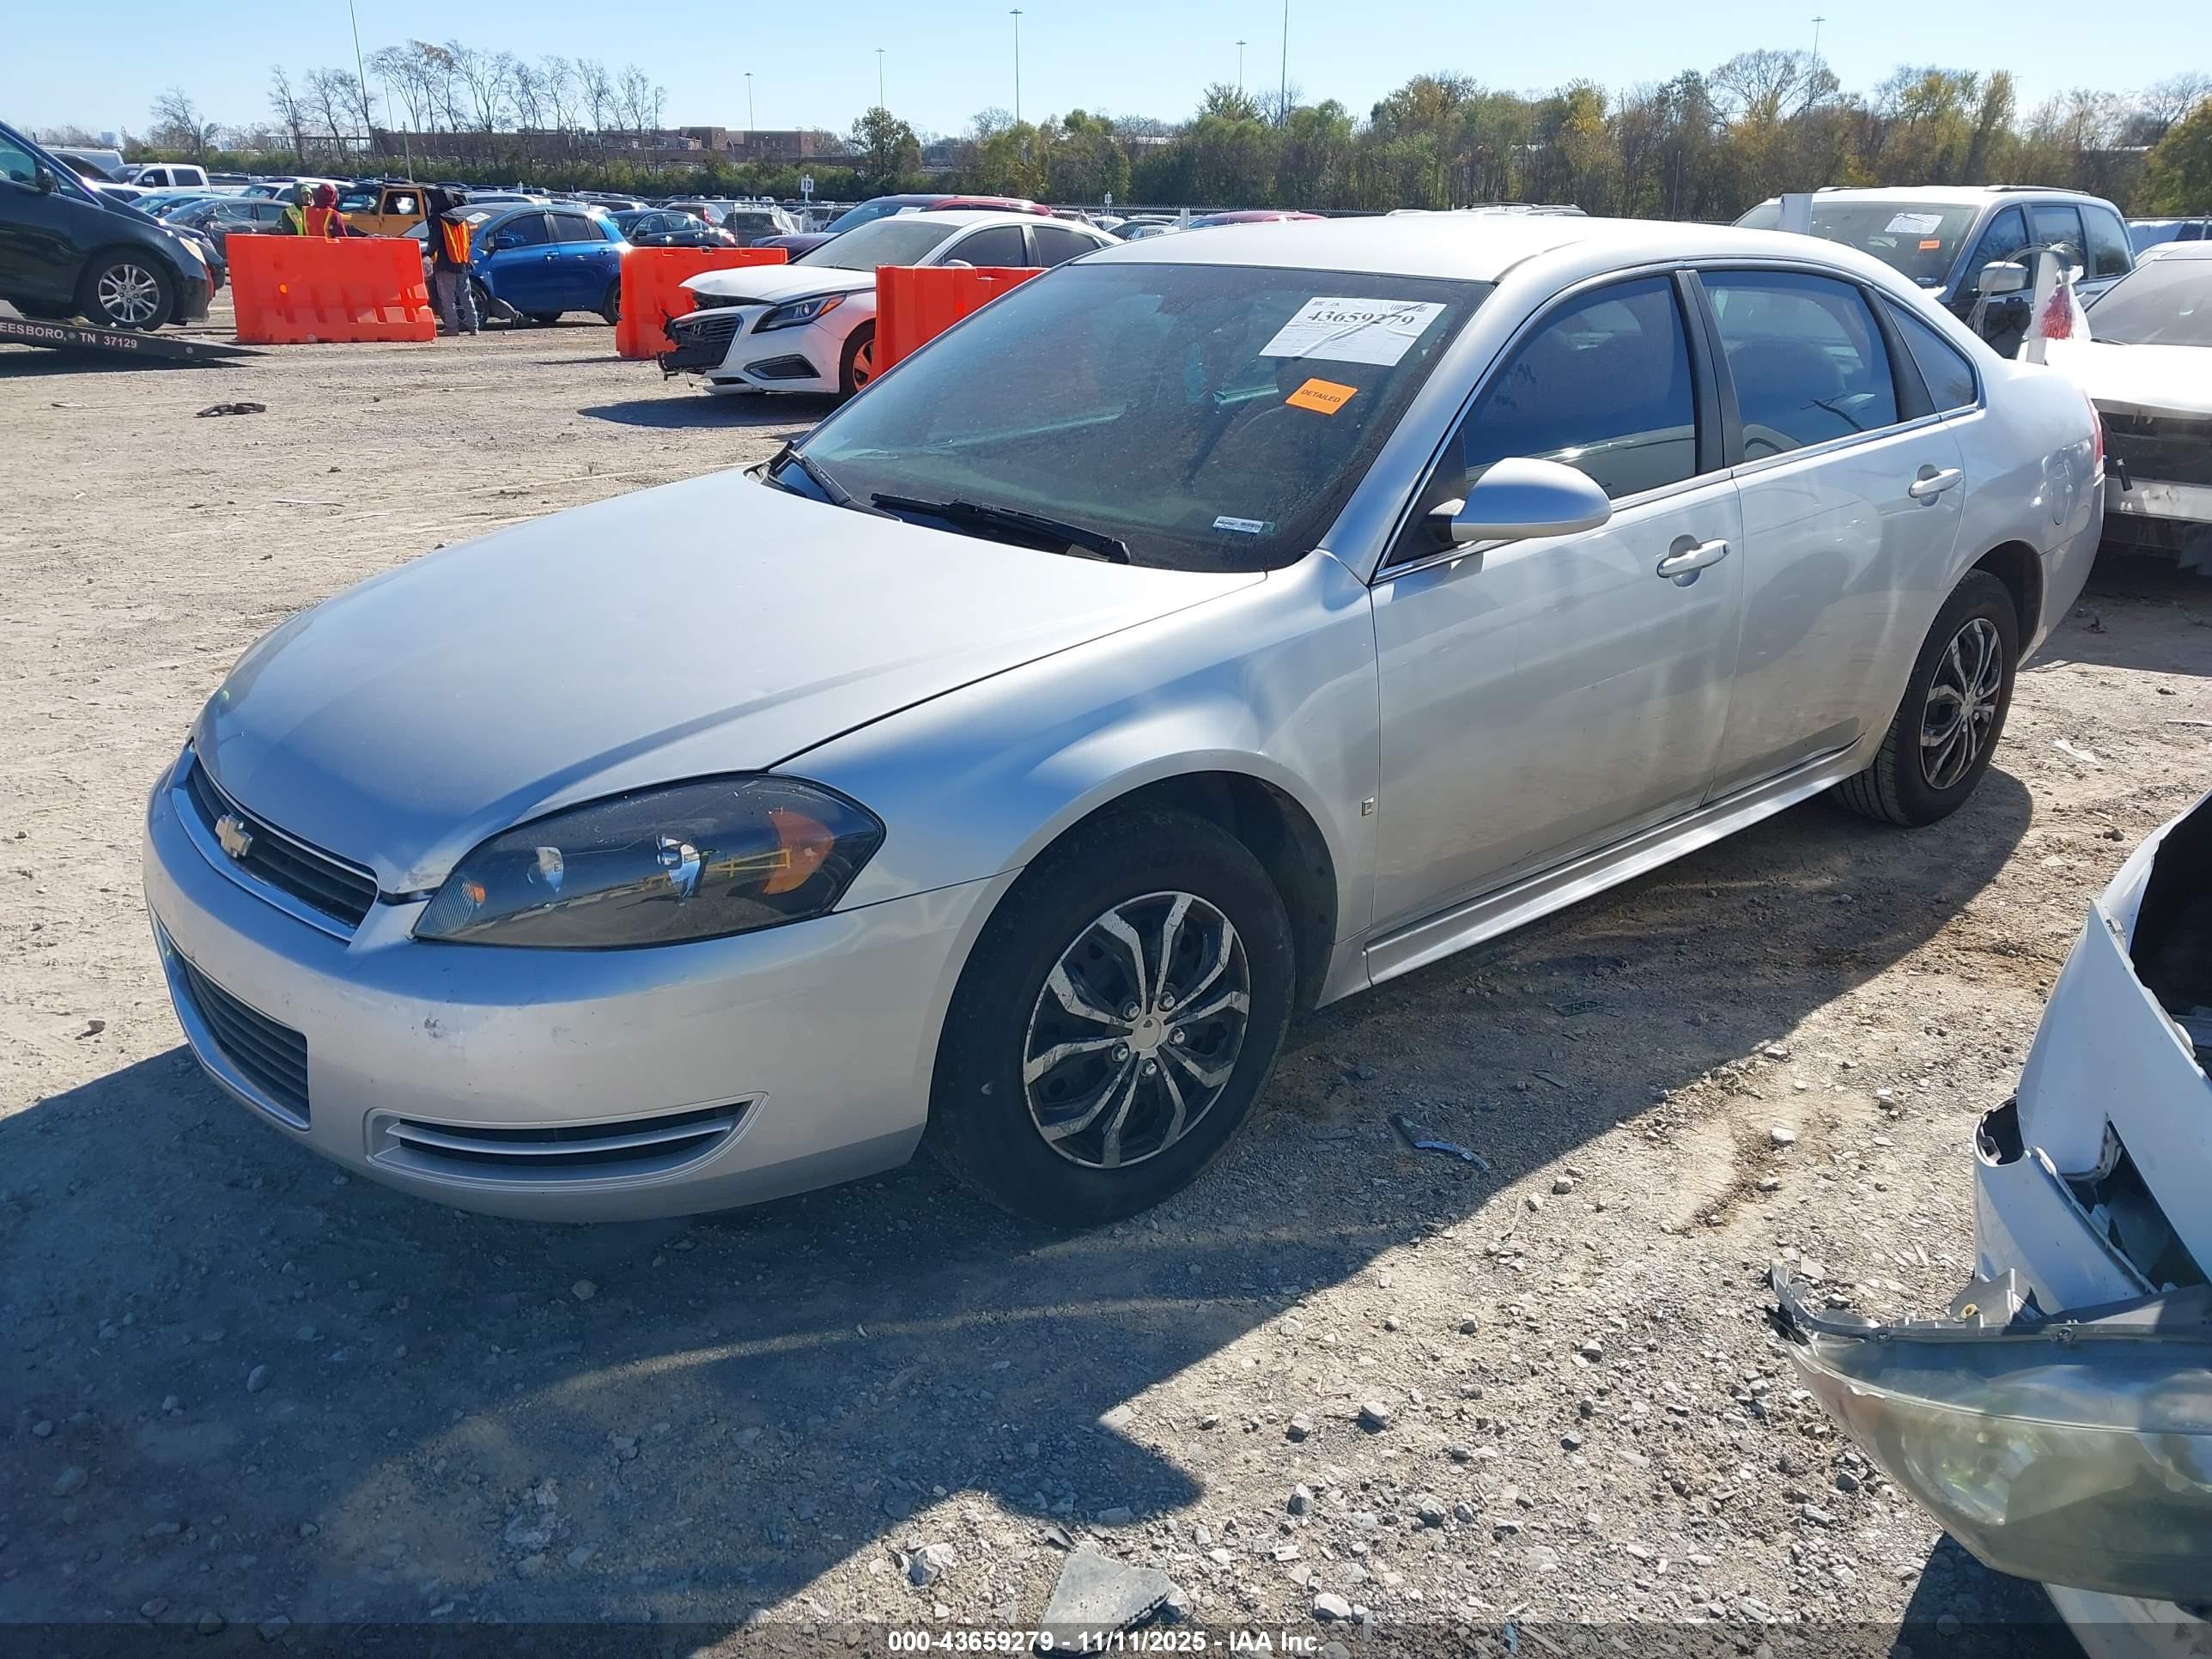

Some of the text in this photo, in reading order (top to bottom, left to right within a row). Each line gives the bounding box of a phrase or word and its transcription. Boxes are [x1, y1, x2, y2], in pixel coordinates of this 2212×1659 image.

[1307, 310, 1415, 326] 43659279
[80, 332, 96, 343] TN
[104, 336, 137, 349] 37129
[1301, 389, 1341, 403] DETAILED
